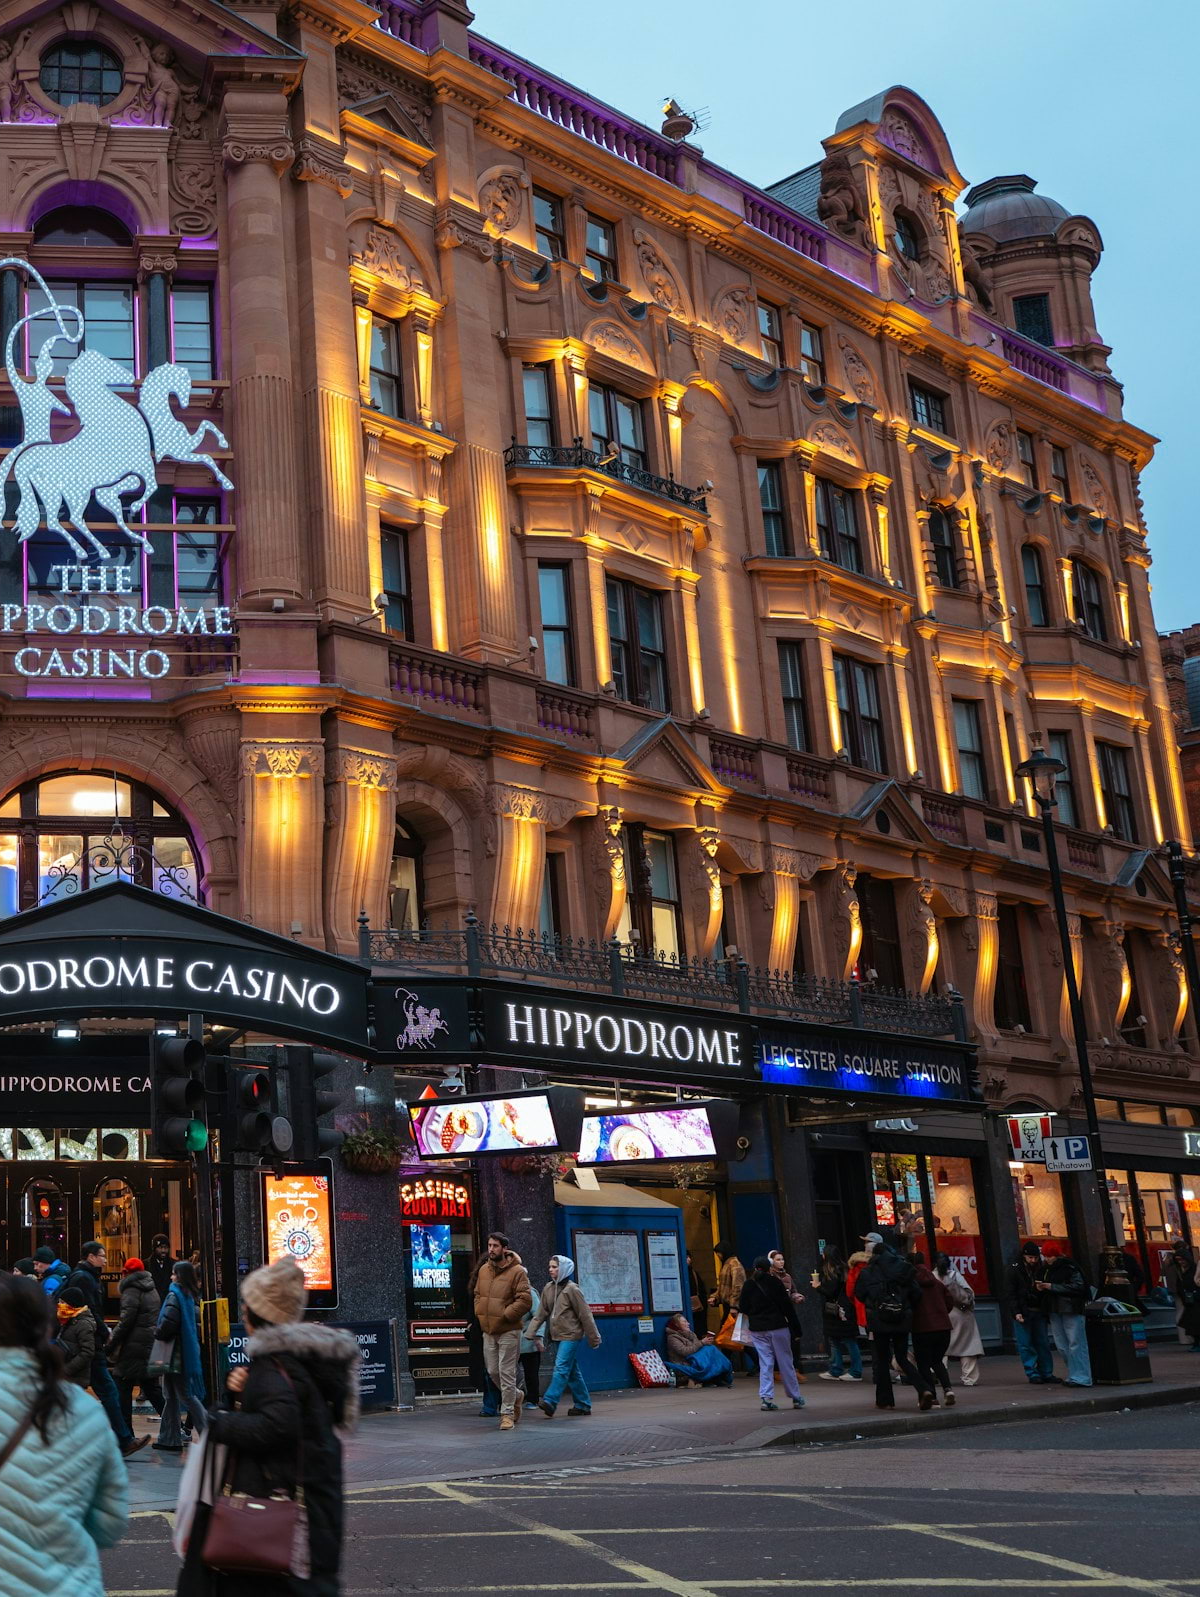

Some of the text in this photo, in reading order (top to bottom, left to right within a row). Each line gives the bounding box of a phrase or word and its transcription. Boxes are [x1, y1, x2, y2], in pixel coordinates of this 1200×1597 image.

[52, 565, 132, 593] THE
[14, 647, 171, 679] CASINO
[186, 960, 341, 1015] CASINO
[506, 1003, 742, 1066] HIPPODROME
[763, 1043, 961, 1085] LEICESTER SQUARE STATION
[1068, 1140, 1083, 1158] P
[401, 1179, 468, 1203] CASINO
[422, 1269, 450, 1278] SPORTS
[948, 1256, 978, 1275] KFC
